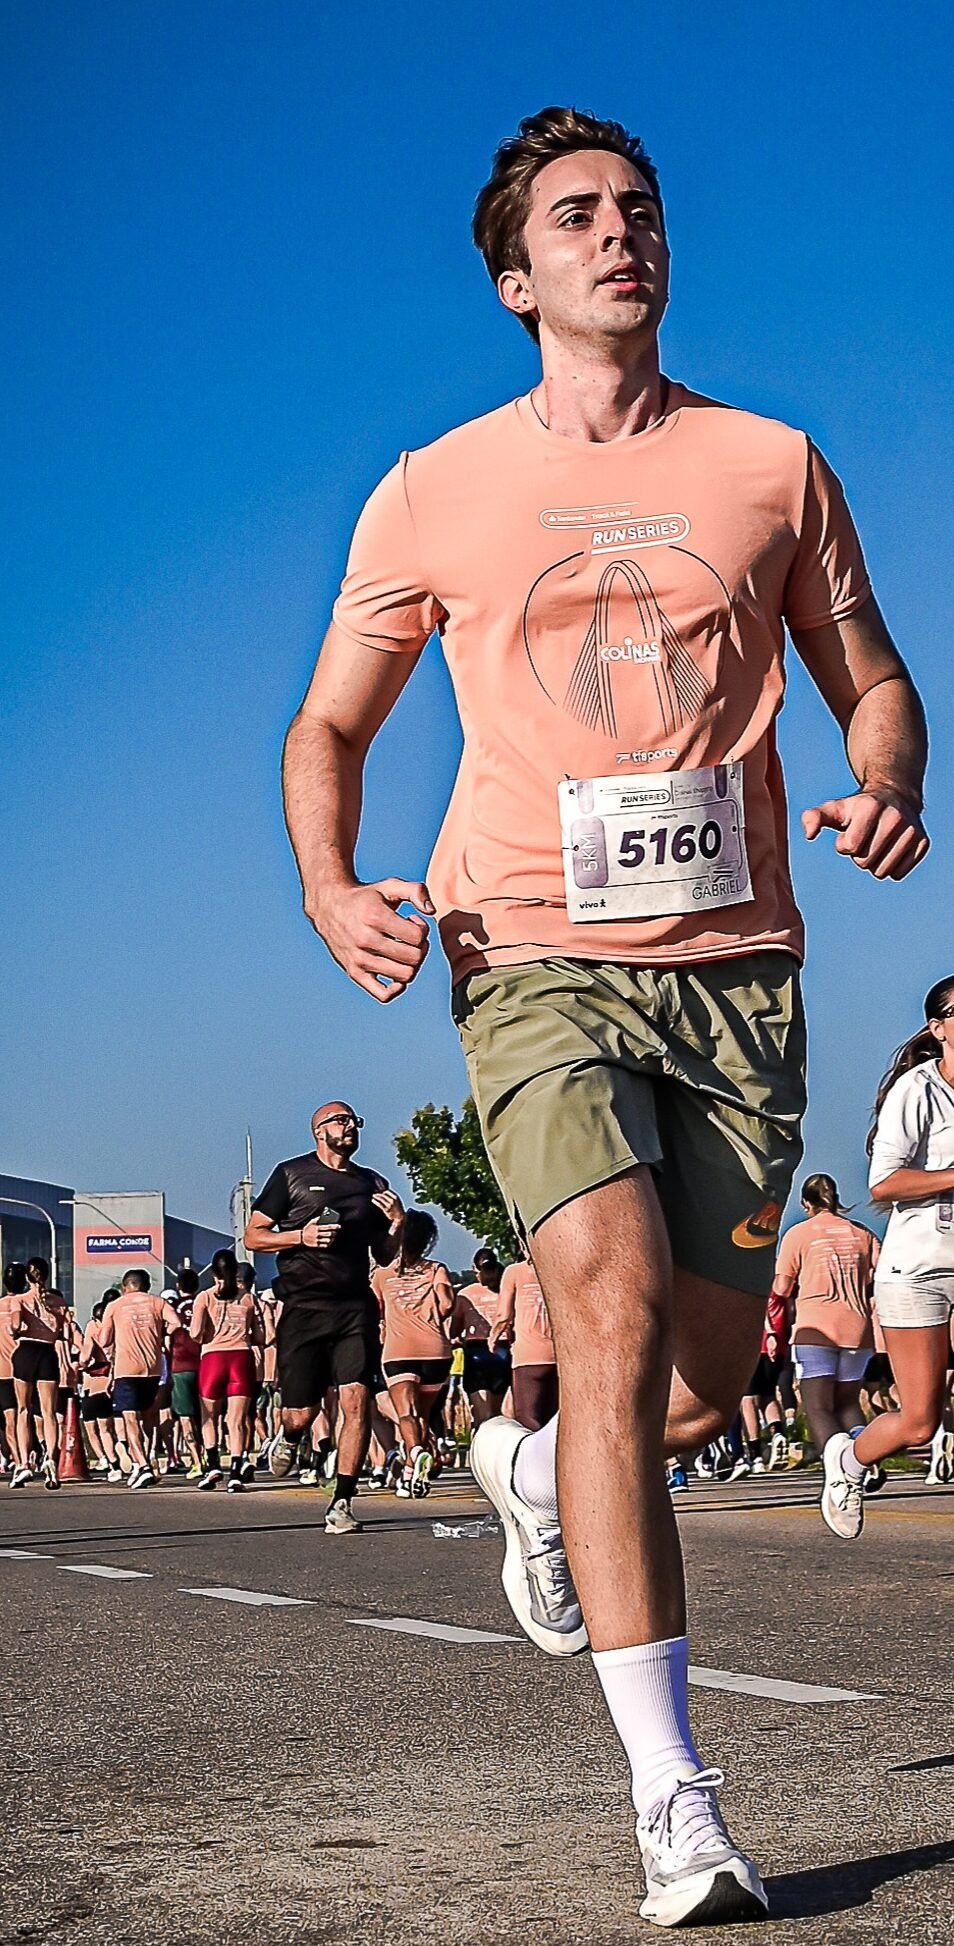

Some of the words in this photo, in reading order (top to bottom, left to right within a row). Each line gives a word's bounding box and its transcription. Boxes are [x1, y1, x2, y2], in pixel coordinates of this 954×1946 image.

[600, 636, 660, 661] COLINAS
[582, 833, 599, 872] 5KM
[617, 820, 722, 868] 5160
[692, 879, 742, 900] GABRIEL
[579, 901, 599, 909] vivo
[88, 1238, 118, 1247] FARMA
[119, 1237, 150, 1246] CONDE
